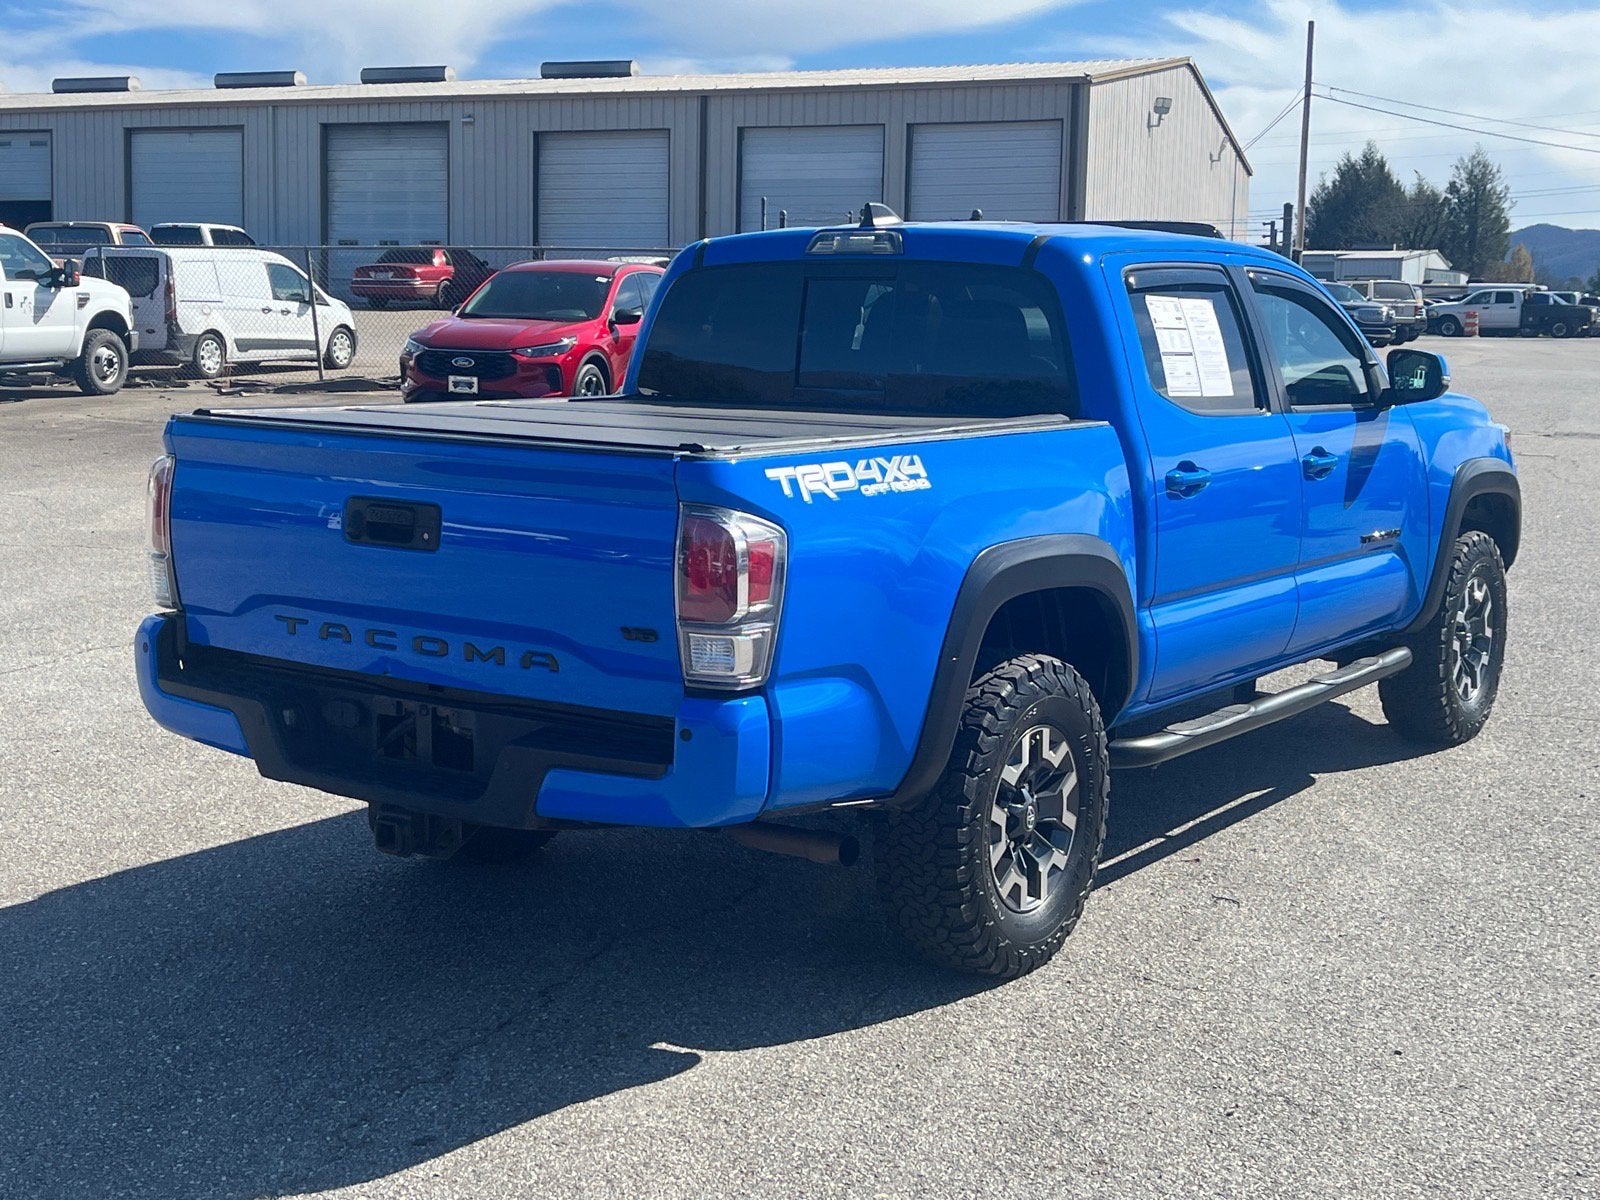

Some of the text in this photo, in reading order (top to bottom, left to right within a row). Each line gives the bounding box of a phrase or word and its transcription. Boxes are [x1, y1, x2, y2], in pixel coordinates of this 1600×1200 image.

[765, 461, 859, 504] TRD
[860, 478, 932, 496] OFF ROAD
[274, 614, 560, 673] TACOMA
